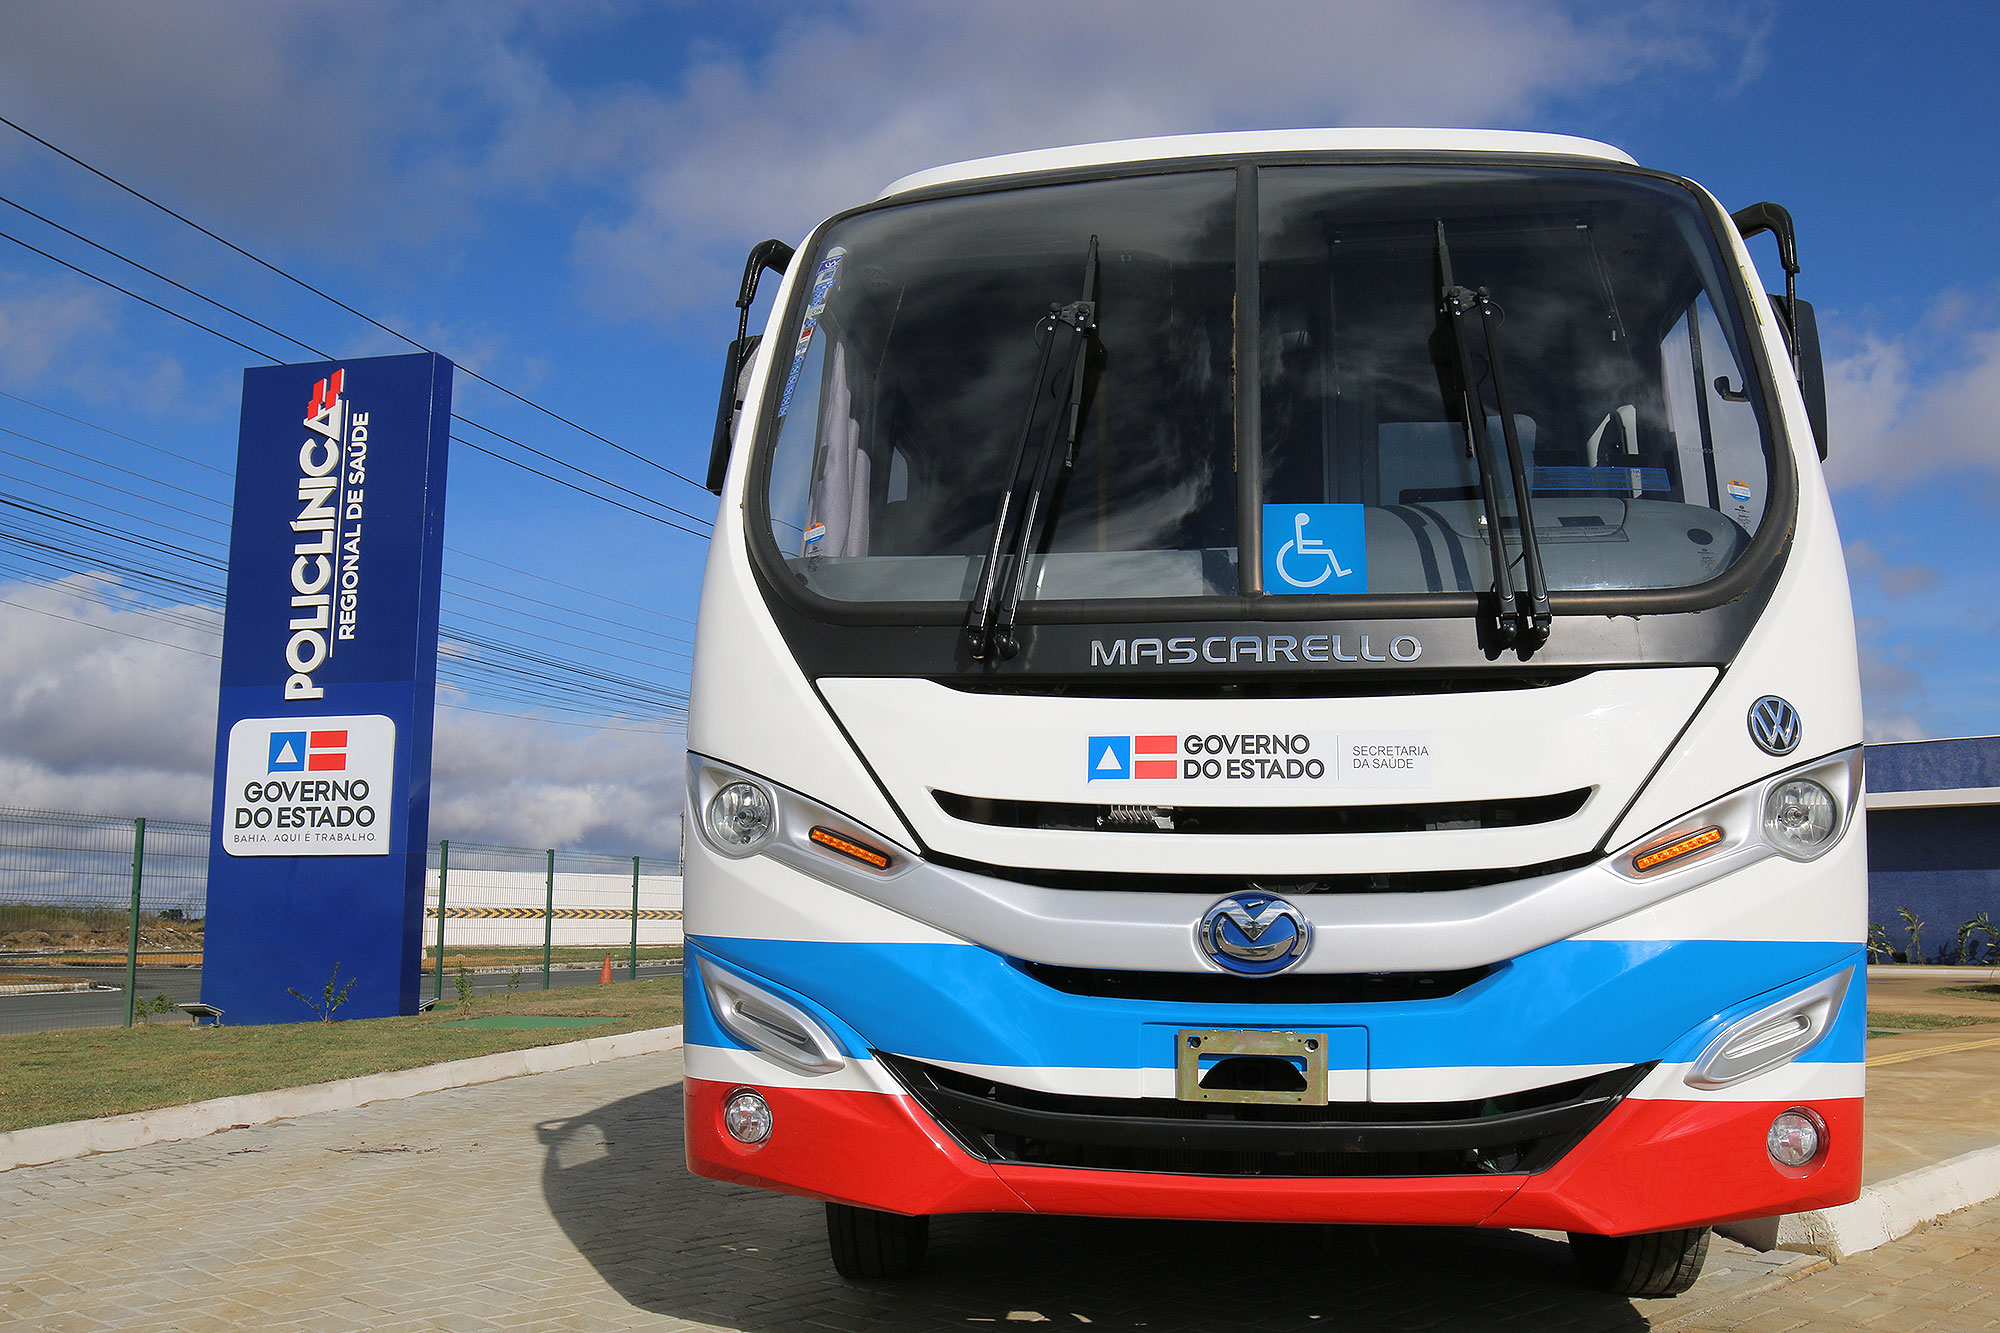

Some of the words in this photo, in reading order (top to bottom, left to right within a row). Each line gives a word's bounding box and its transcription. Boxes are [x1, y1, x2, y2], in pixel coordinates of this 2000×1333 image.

[347, 411, 370, 485] SAÚDE
[345, 489, 364, 520] DE
[284, 398, 343, 700] POLICLÍNICA
[338, 523, 362, 640] REGIONAL
[1090, 634, 1423, 666] MASCARELLO
[1183, 734, 1311, 755] GOVERNO
[1352, 745, 1430, 757] SECRETARIA
[1183, 758, 1222, 779] DO
[1226, 758, 1325, 779] ESTADO
[1353, 758, 1370, 769] DA
[1372, 756, 1415, 769] SAÚDE
[243, 779, 370, 803] GOVERNO
[234, 806, 273, 829] DO
[276, 805, 376, 828] ESTADO
[233, 833, 270, 843] BAHIA.
[273, 833, 301, 843] AQUI
[304, 830, 311, 842] É
[314, 832, 377, 842] TRABALHO.
